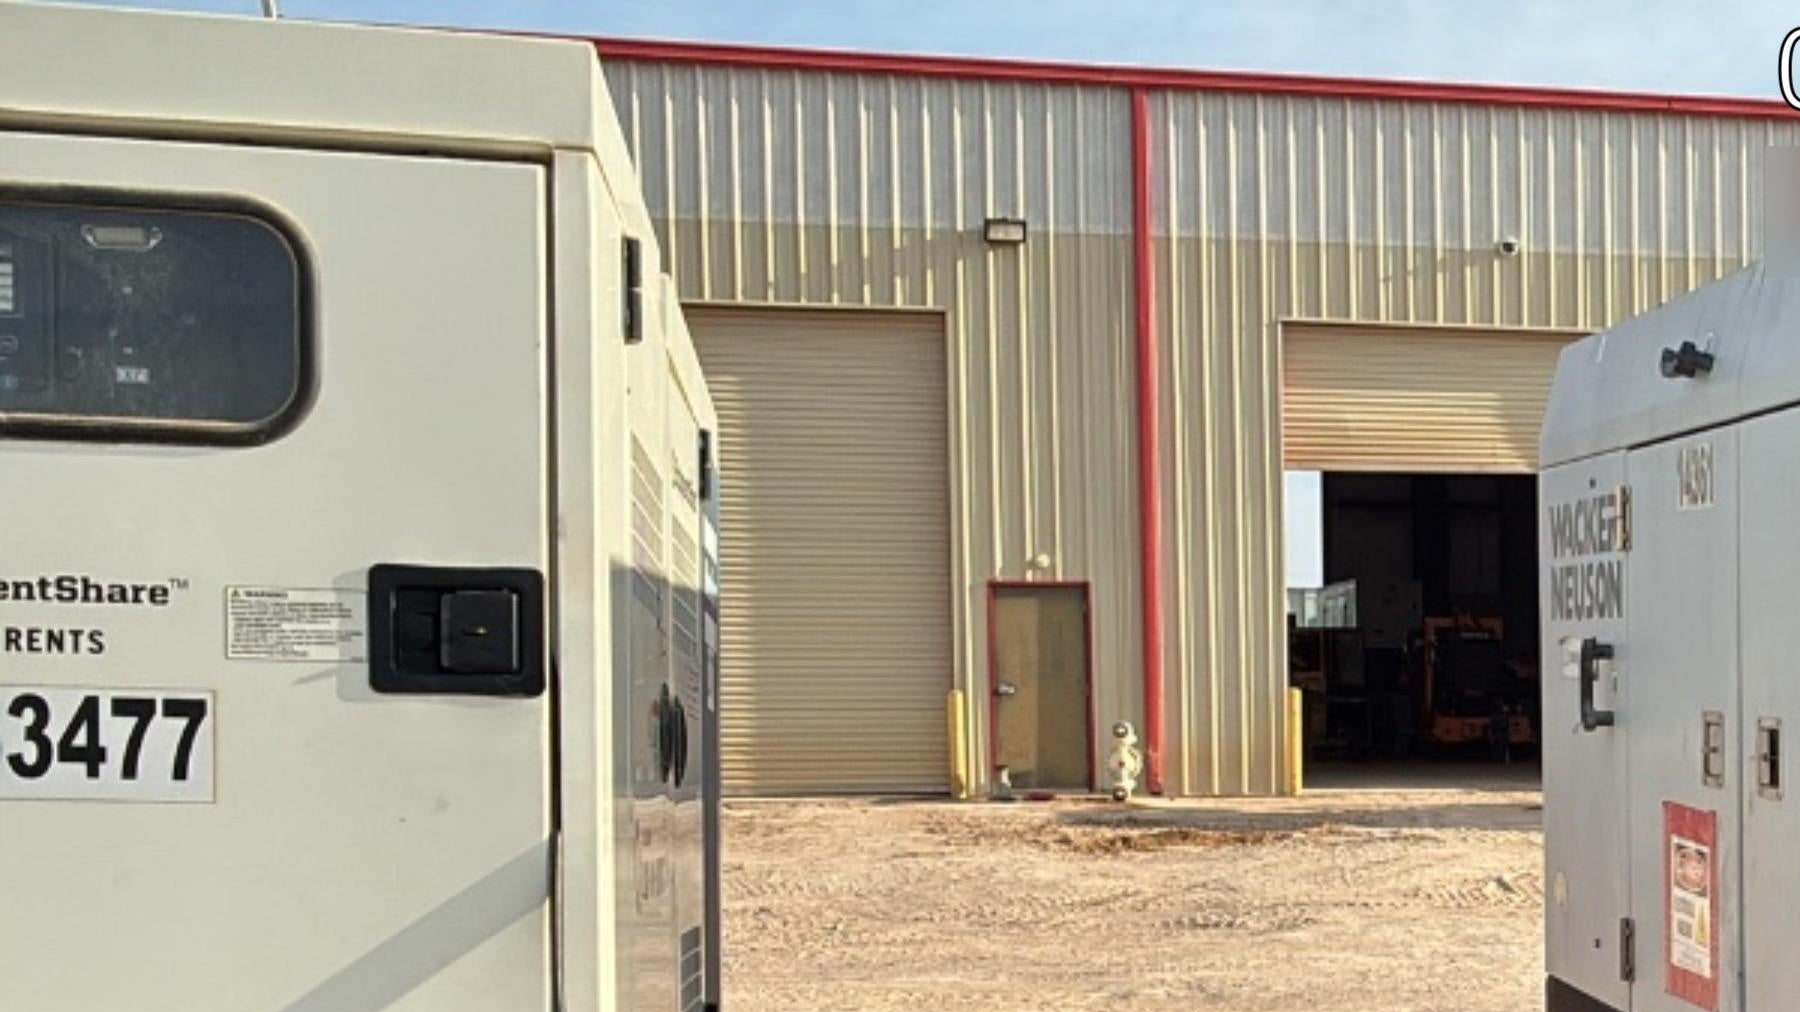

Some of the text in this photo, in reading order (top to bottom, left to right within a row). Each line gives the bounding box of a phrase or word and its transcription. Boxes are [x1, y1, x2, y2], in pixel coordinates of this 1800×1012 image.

[1550, 559, 1624, 622] NEUSON
[5, 627, 105, 654] RENTS
[0, 692, 208, 781] 3477
